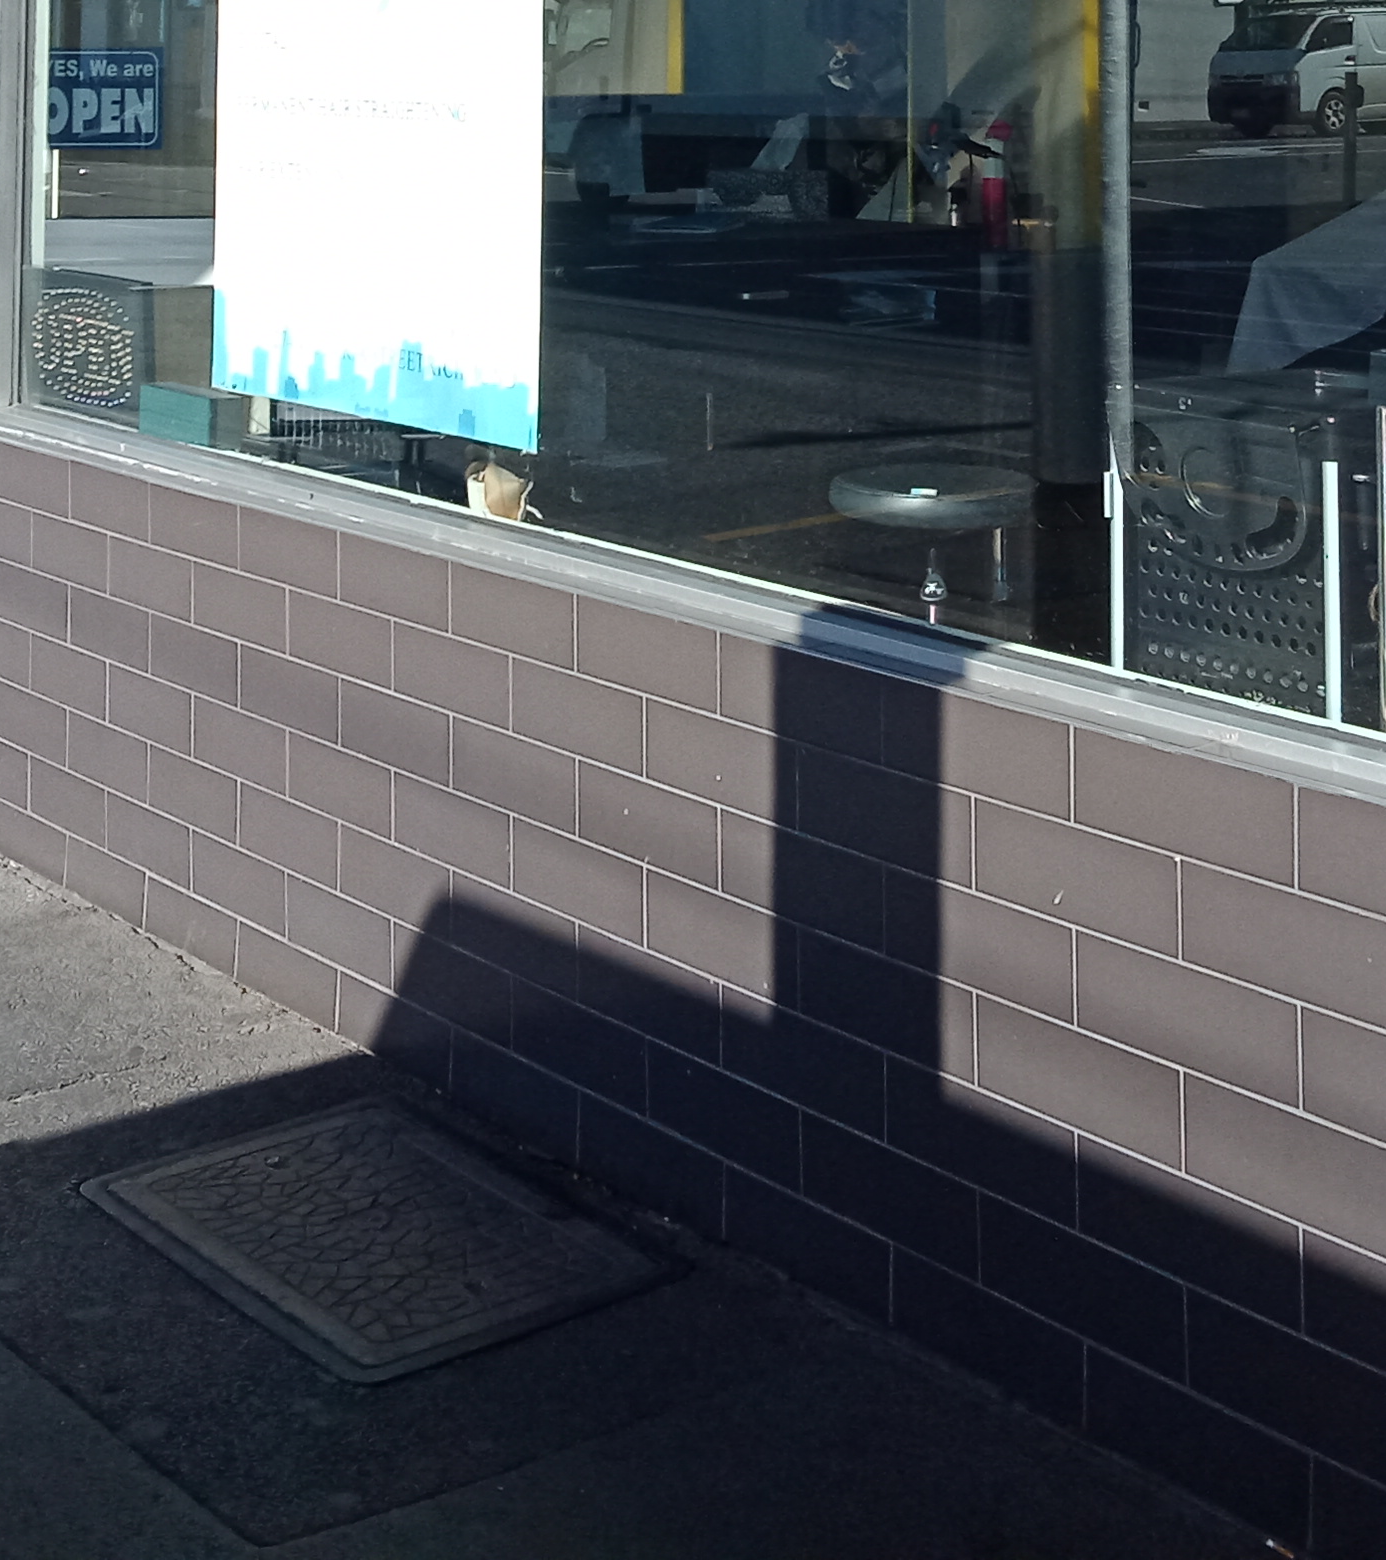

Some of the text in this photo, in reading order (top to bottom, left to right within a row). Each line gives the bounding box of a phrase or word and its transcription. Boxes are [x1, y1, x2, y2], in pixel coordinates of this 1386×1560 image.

[89, 59, 118, 77] We
[123, 63, 154, 77] are
[47, 86, 154, 135] OPEN
